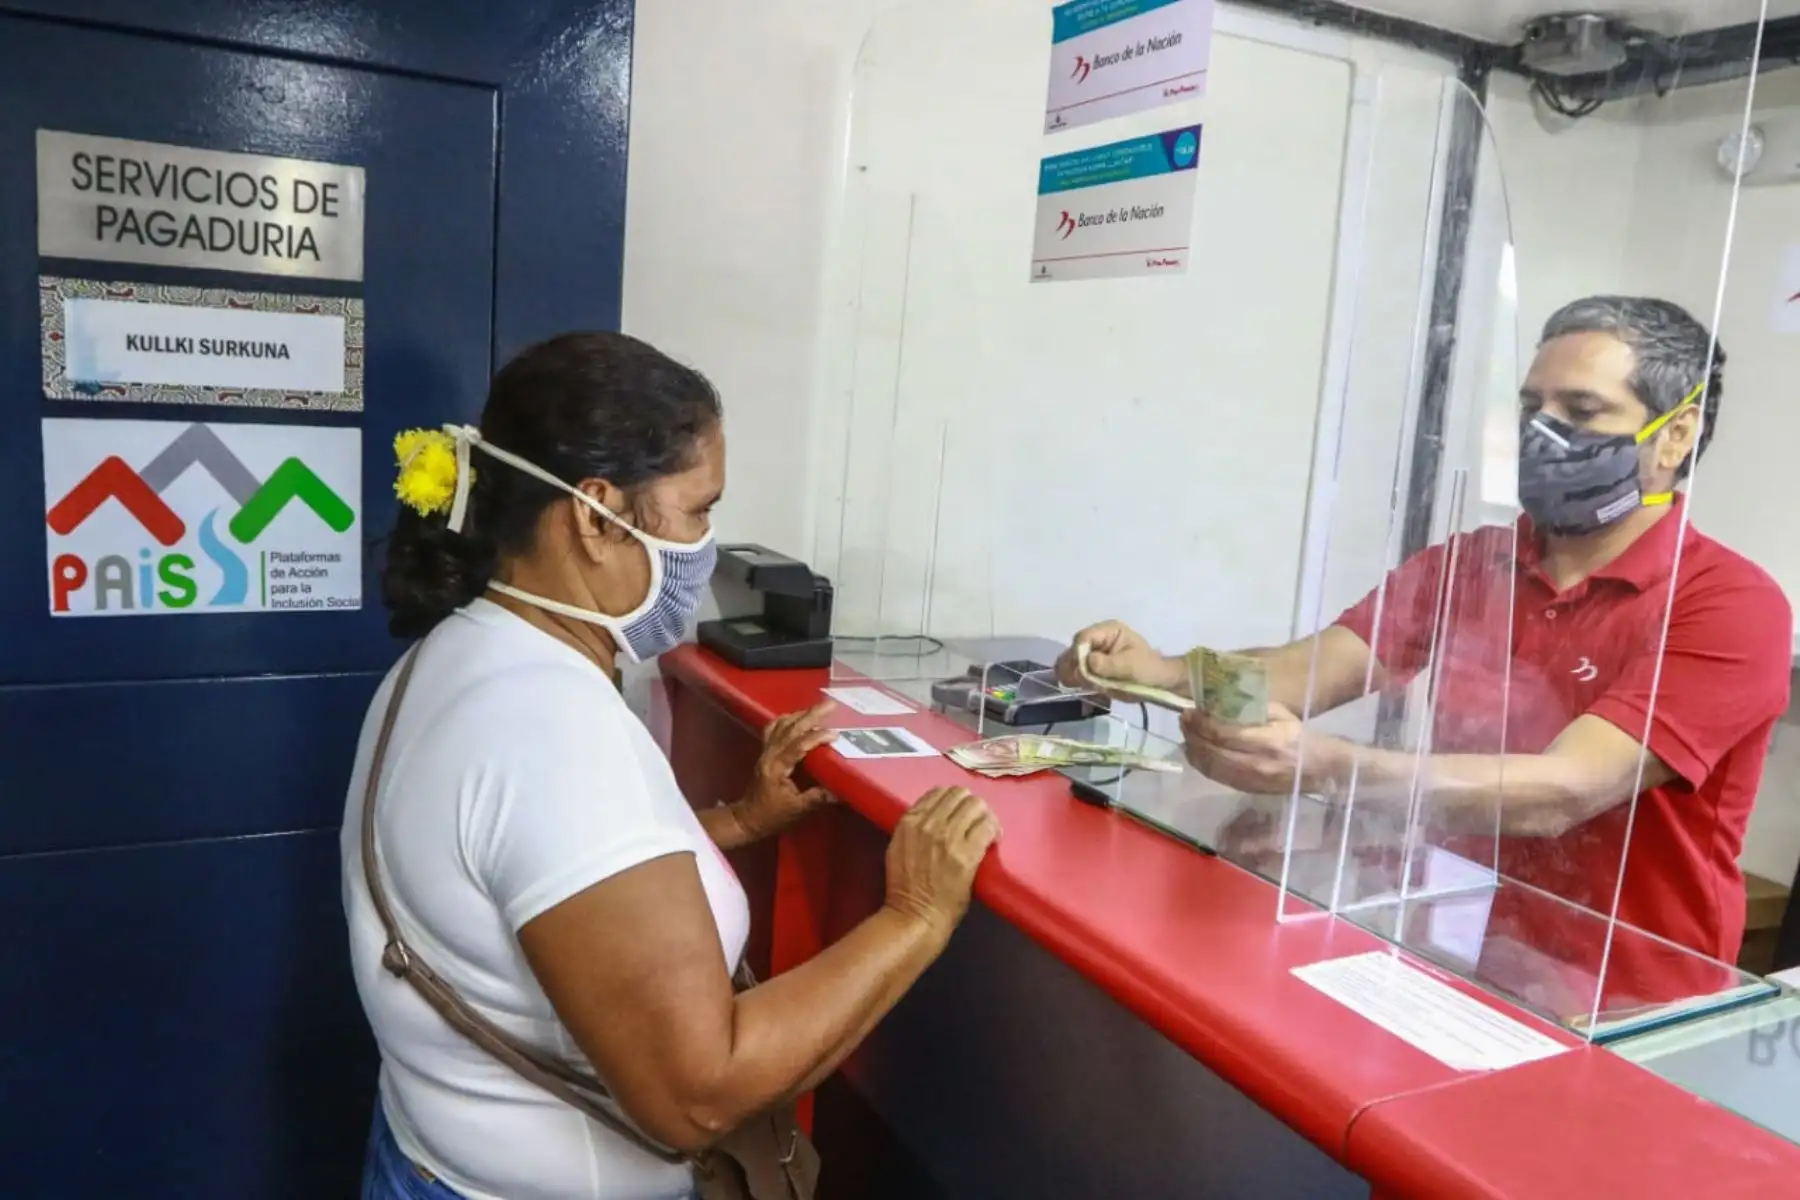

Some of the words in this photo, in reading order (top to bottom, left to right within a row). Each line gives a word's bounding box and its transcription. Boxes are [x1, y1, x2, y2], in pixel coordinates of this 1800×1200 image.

[1092, 53, 1120, 71] Banco
[1121, 45, 1134, 63] de
[1135, 42, 1145, 58] la
[1146, 29, 1183, 54] Nación
[71, 152, 279, 211] SERVICIOS
[292, 179, 339, 218] DE
[1077, 212, 1105, 229] Banco
[1106, 209, 1118, 225] de
[1119, 206, 1129, 223] la
[1130, 201, 1165, 221] Nación
[95, 204, 321, 262] PAGADURIA
[126, 333, 194, 355] KULLKI
[199, 337, 291, 361] SURKUNA
[270, 551, 341, 564] Plataformas
[270, 567, 285, 579] de
[288, 566, 328, 579] Acción
[271, 583, 298, 595] para
[301, 581, 312, 594] la
[271, 597, 324, 609] Inclusión
